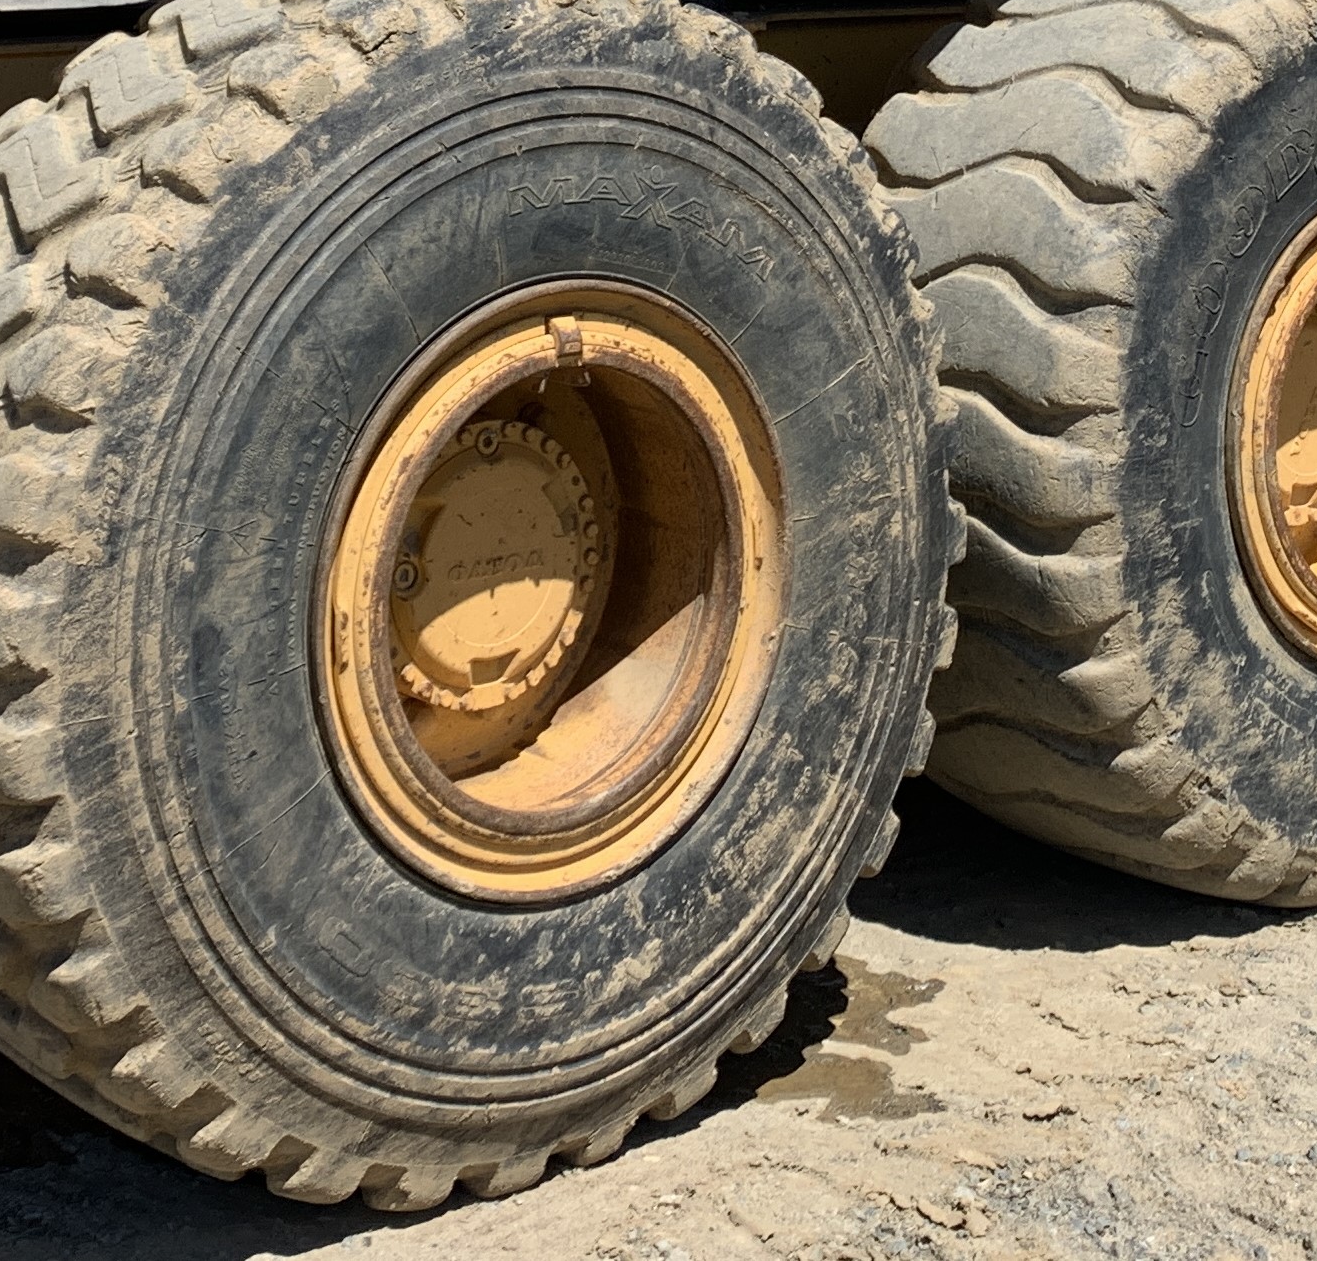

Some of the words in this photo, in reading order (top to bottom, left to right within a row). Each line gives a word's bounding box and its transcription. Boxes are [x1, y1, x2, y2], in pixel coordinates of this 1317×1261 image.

[507, 165, 775, 282] MAXAM
[283, 379, 352, 525] TUBELESS
[293, 425, 349, 580] CONSTRUCTION
